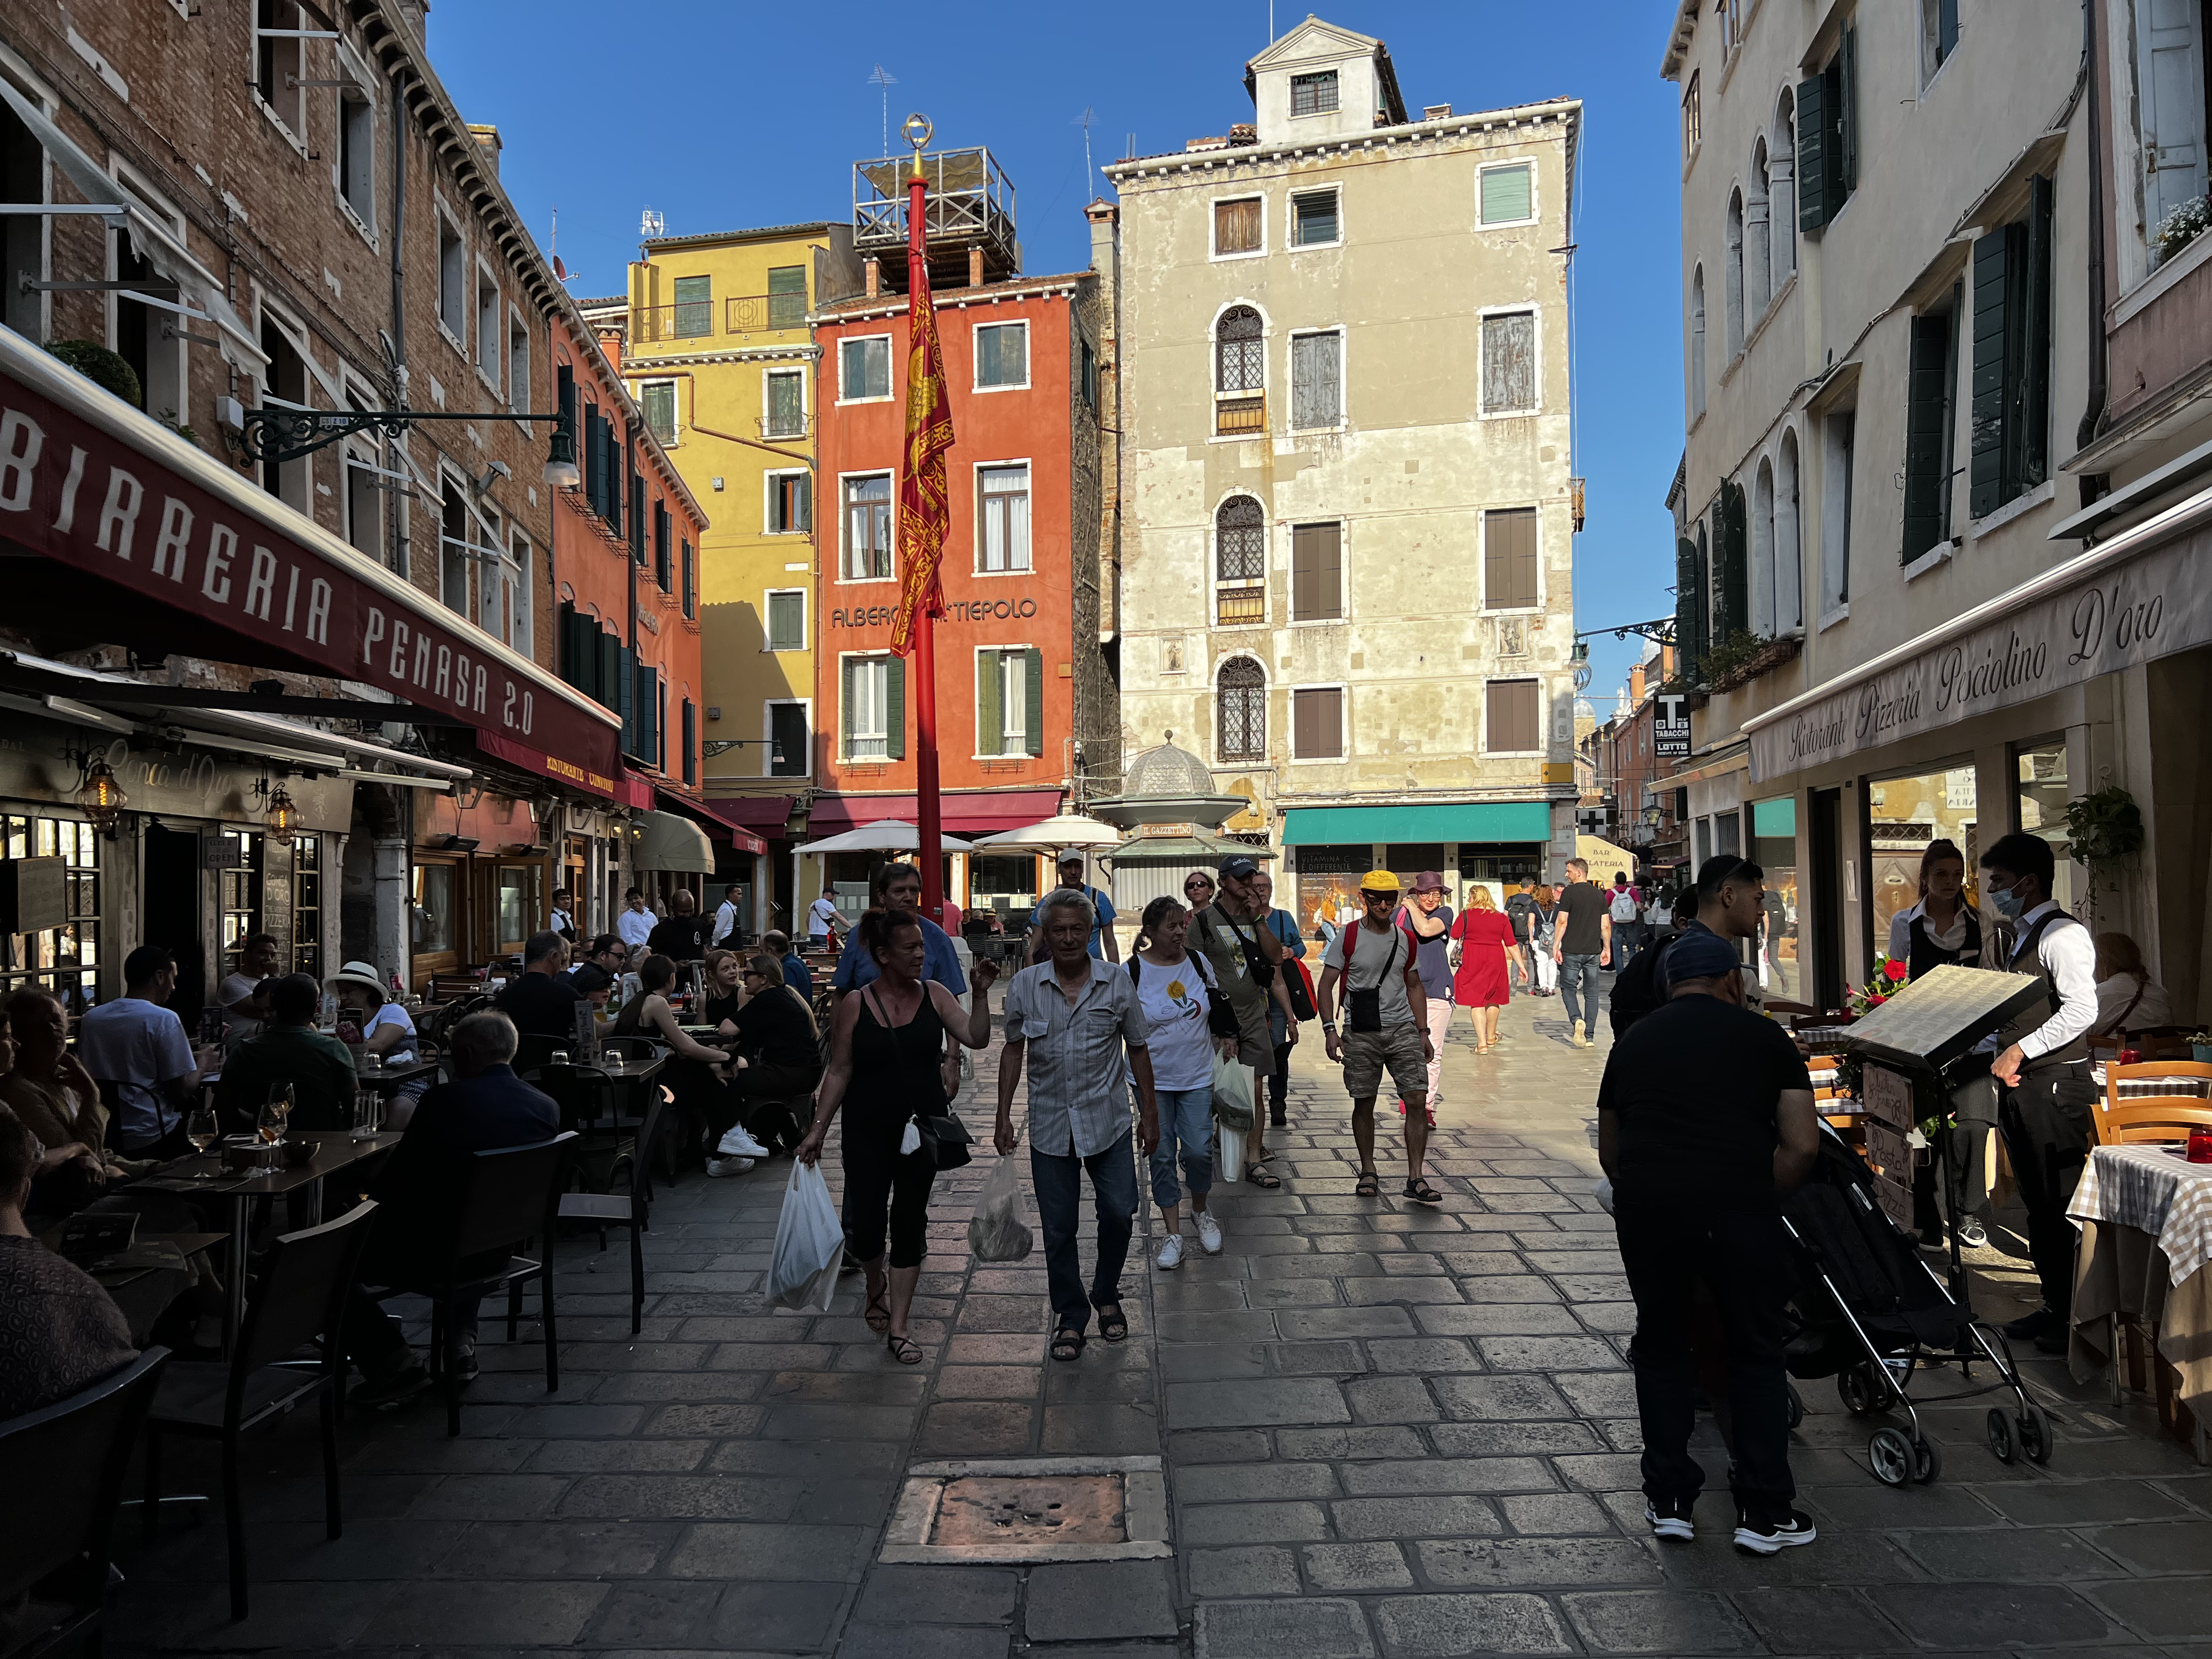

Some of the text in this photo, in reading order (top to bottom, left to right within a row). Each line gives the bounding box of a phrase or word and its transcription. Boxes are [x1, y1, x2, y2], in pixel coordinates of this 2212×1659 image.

[0, 406, 534, 735] BIRRERIA PENASA 2.0
[832, 597, 1037, 628] ALBER TIEPOLO
[1789, 586, 2163, 762] Ristorante Pizzeria Pesciolino D'oro
[1658, 694, 1684, 729] T
[547, 755, 584, 782] RISTORANTE
[1143, 826, 1191, 835] IL GAZZETTINO
[210, 854, 234, 862] OPEN
[266, 843, 291, 855] WELCOME
[1232, 858, 1252, 866] adidas
[266, 873, 289, 887] CONCA
[265, 914, 291, 929] PIZZERIA
[1871, 1129, 1903, 1172] Pasta
